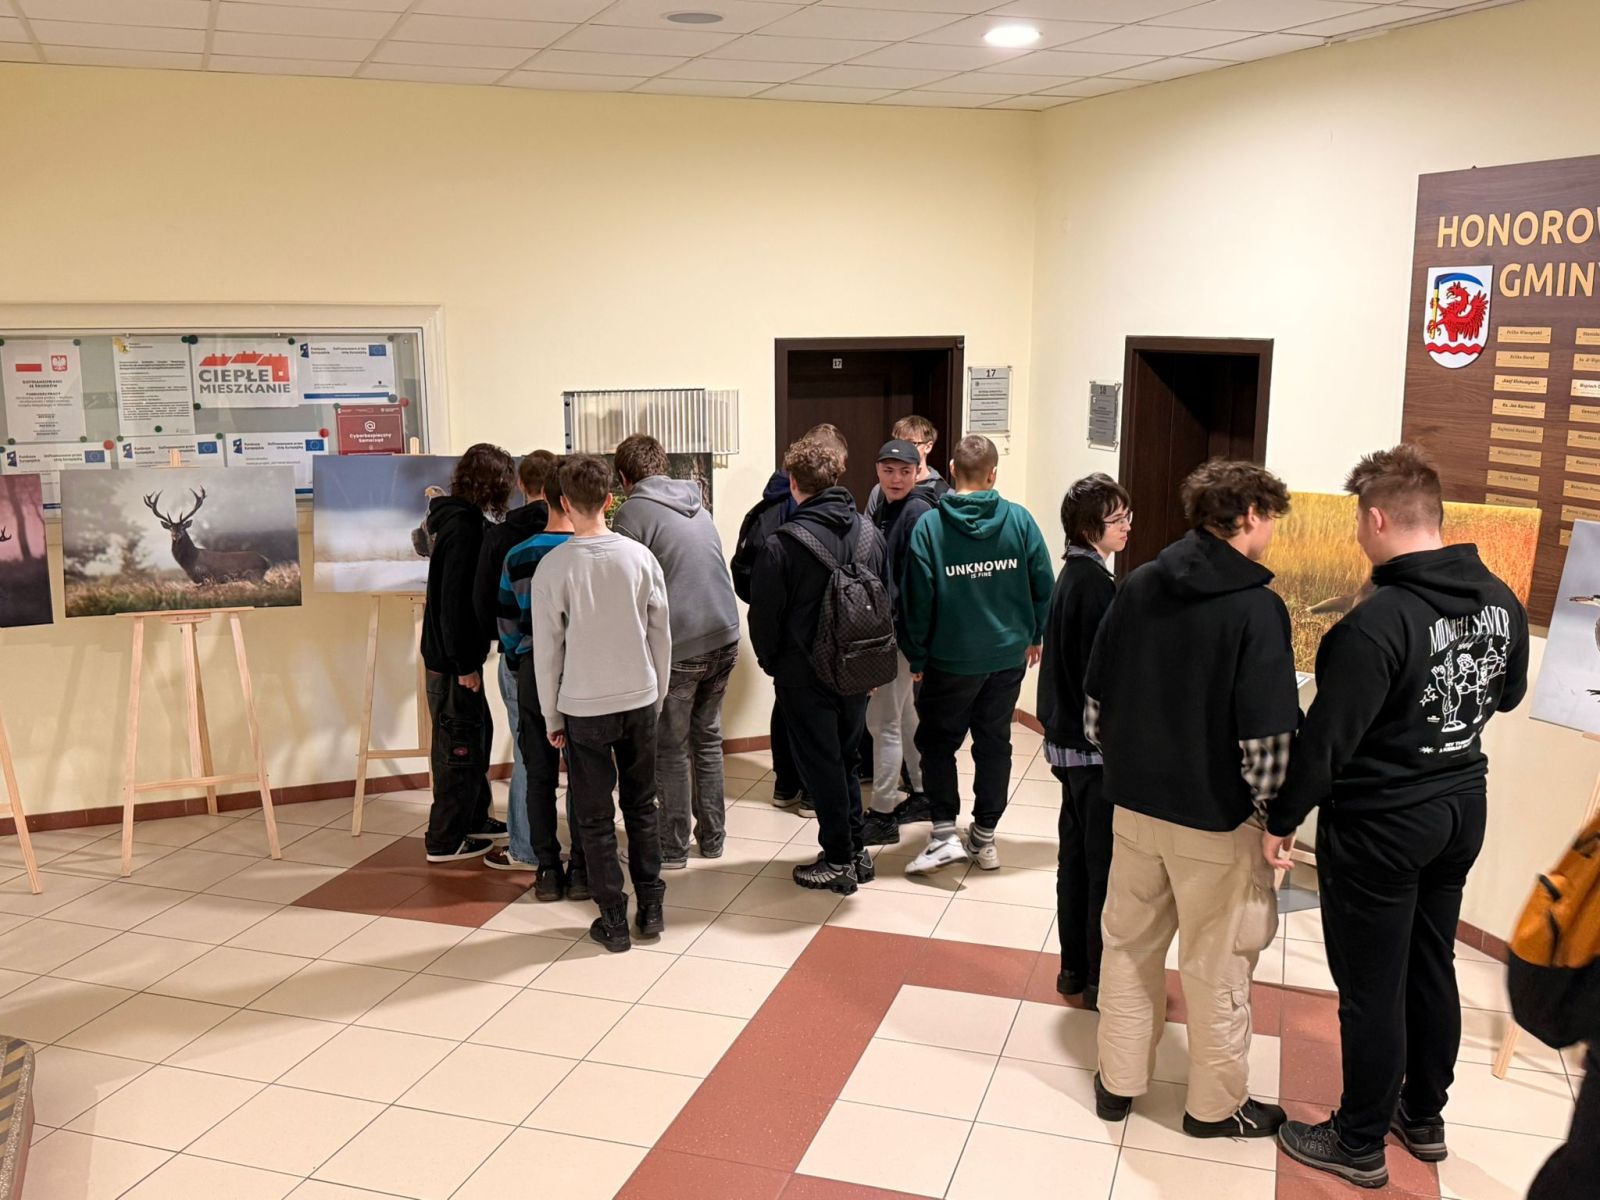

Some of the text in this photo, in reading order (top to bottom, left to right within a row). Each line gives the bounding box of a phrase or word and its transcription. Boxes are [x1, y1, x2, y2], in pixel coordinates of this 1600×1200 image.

[1437, 206, 1600, 248] HONORO
[1499, 262, 1600, 298] GMIN
[198, 369, 269, 383] CIEPŁE
[986, 369, 996, 377] 17
[199, 383, 291, 394] MIESZKANIE
[945, 559, 1017, 576] UNKNOWN
